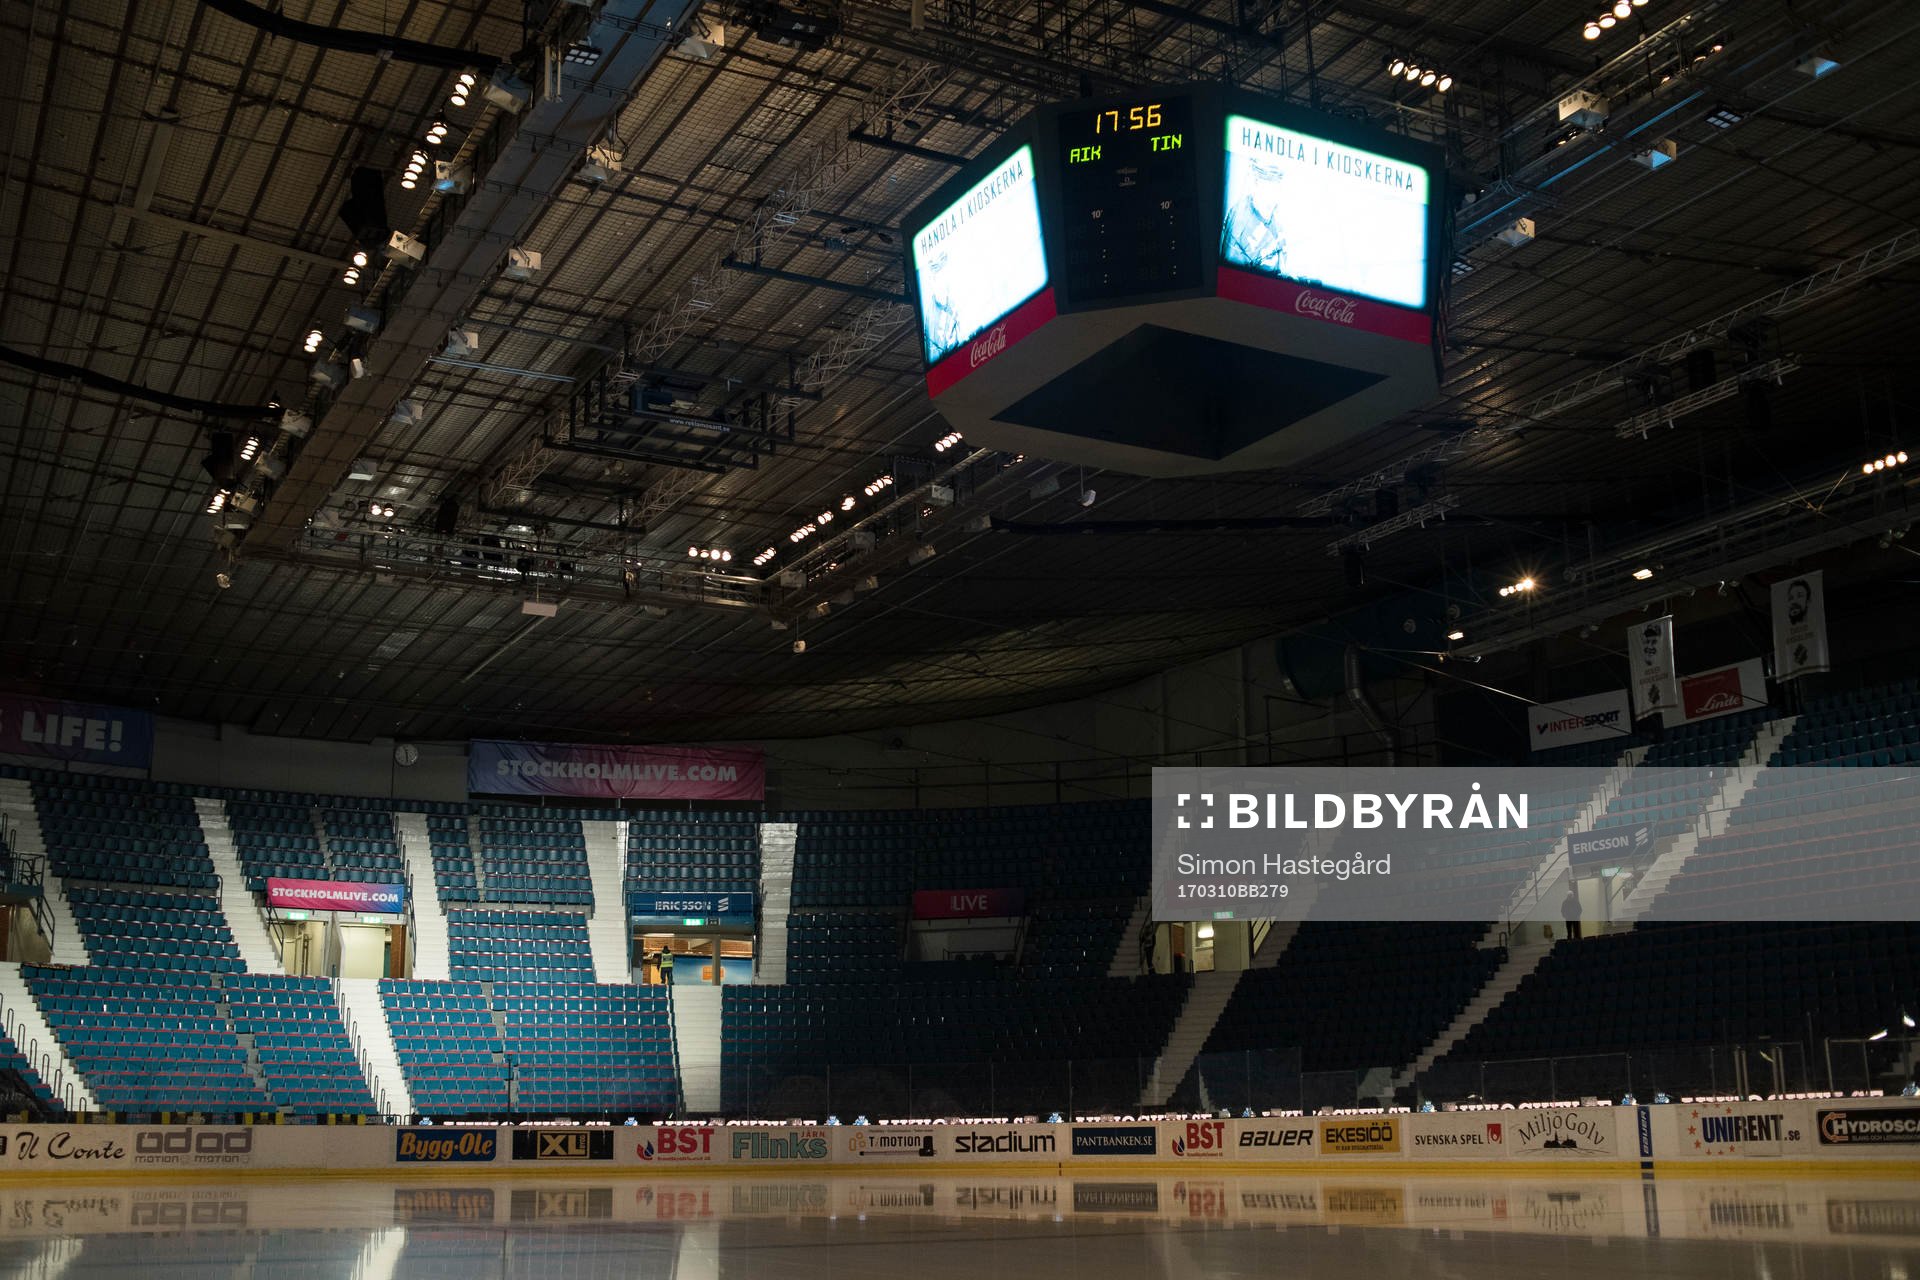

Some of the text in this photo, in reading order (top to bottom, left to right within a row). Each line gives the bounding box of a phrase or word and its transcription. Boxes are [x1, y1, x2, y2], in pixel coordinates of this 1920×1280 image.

[1095, 103, 1162, 134] 17:56
[1150, 133, 1183, 152] TIN
[1069, 145, 1102, 164] AIK
[1242, 127, 1414, 192] HANDLA I KIOSKERNA
[921, 213, 957, 255] HANDLA
[967, 160, 1024, 218] KIOSKERNA
[1695, 692, 1740, 714] Linde
[20, 710, 123, 753] LIFE!
[1550, 710, 1620, 733] INTERSPORT
[496, 760, 737, 782] STOCKHOLMLIVE.COM
[1572, 836, 1630, 855] ERICSSON
[271, 887, 399, 903] STOCKHOLMLIVE.COM
[655, 900, 712, 911] ERICSSON
[950, 895, 989, 912] LIVE
[657, 1128, 715, 1154] BST
[955, 1131, 1056, 1153] stadium
[1076, 1135, 1153, 1147] PANTBANKEN.SE
[1186, 1122, 1225, 1149] BST
[1326, 1122, 1393, 1143] EKESIÖÖ
[1415, 1133, 1484, 1146] SVENSKA SPEL
[47, 1131, 125, 1160] Conte
[542, 1134, 586, 1155] XL
[732, 1132, 828, 1159] Flinks
